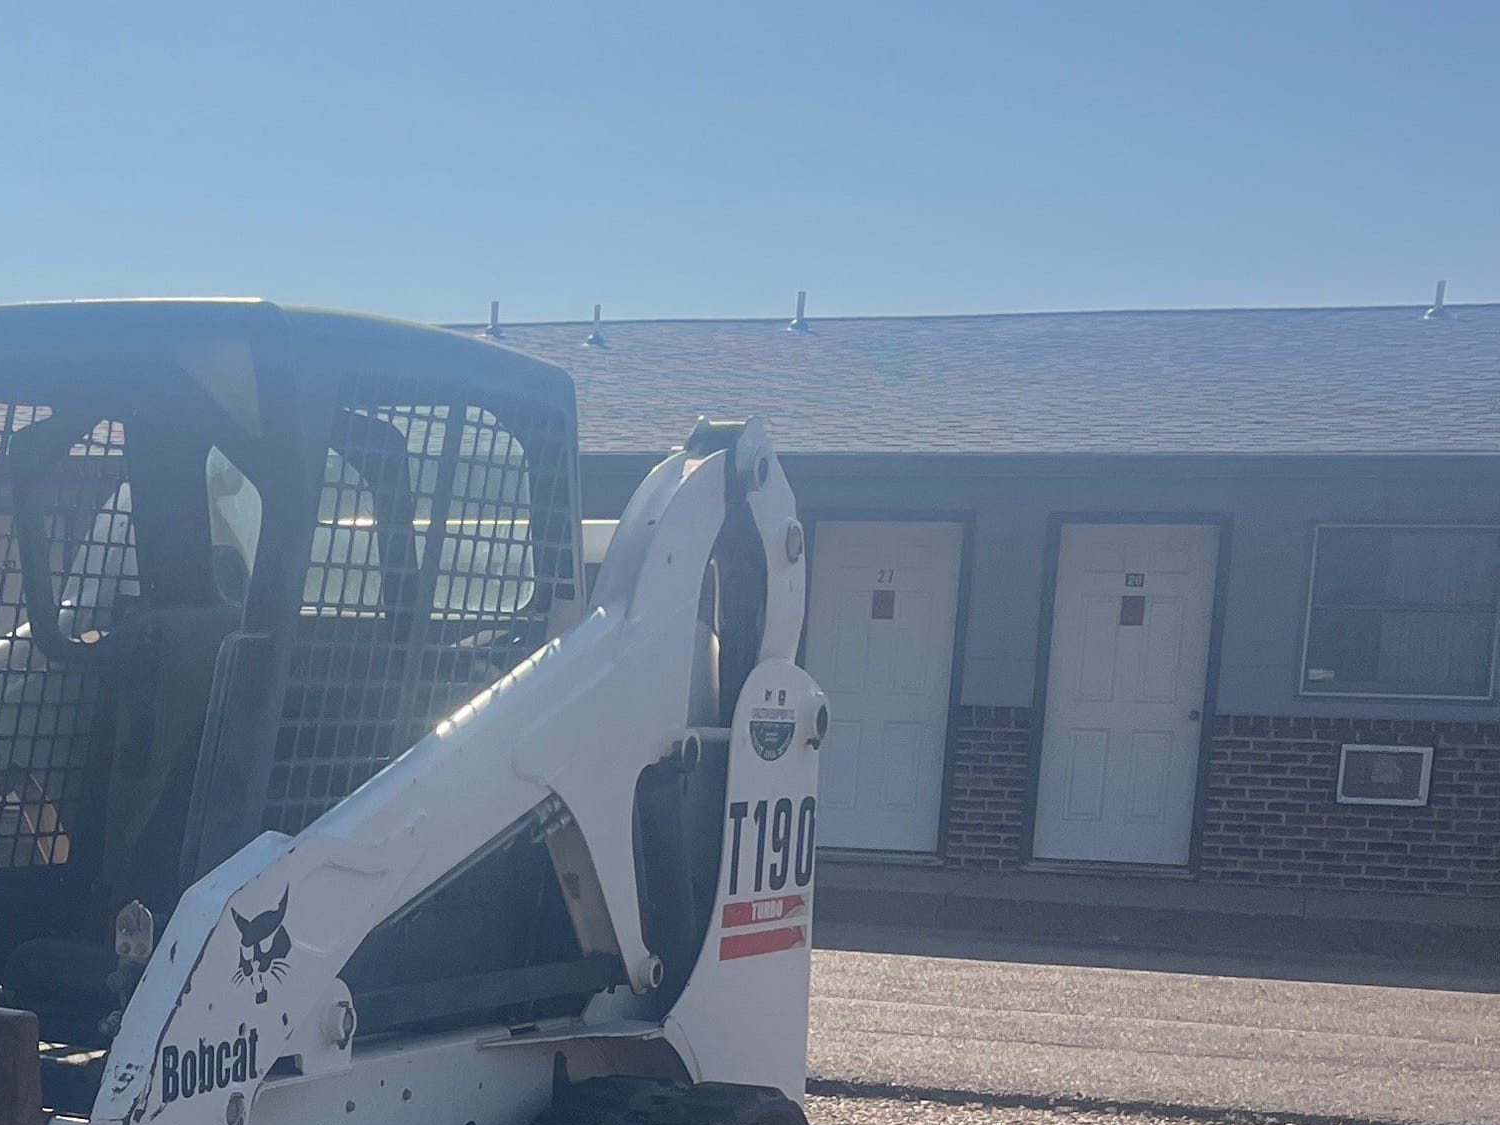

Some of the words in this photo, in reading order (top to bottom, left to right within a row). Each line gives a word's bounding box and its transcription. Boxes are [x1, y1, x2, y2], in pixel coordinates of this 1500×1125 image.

[877, 569, 895, 583] 27
[727, 796, 815, 896] T190
[162, 1028, 258, 1103] Bobcat
